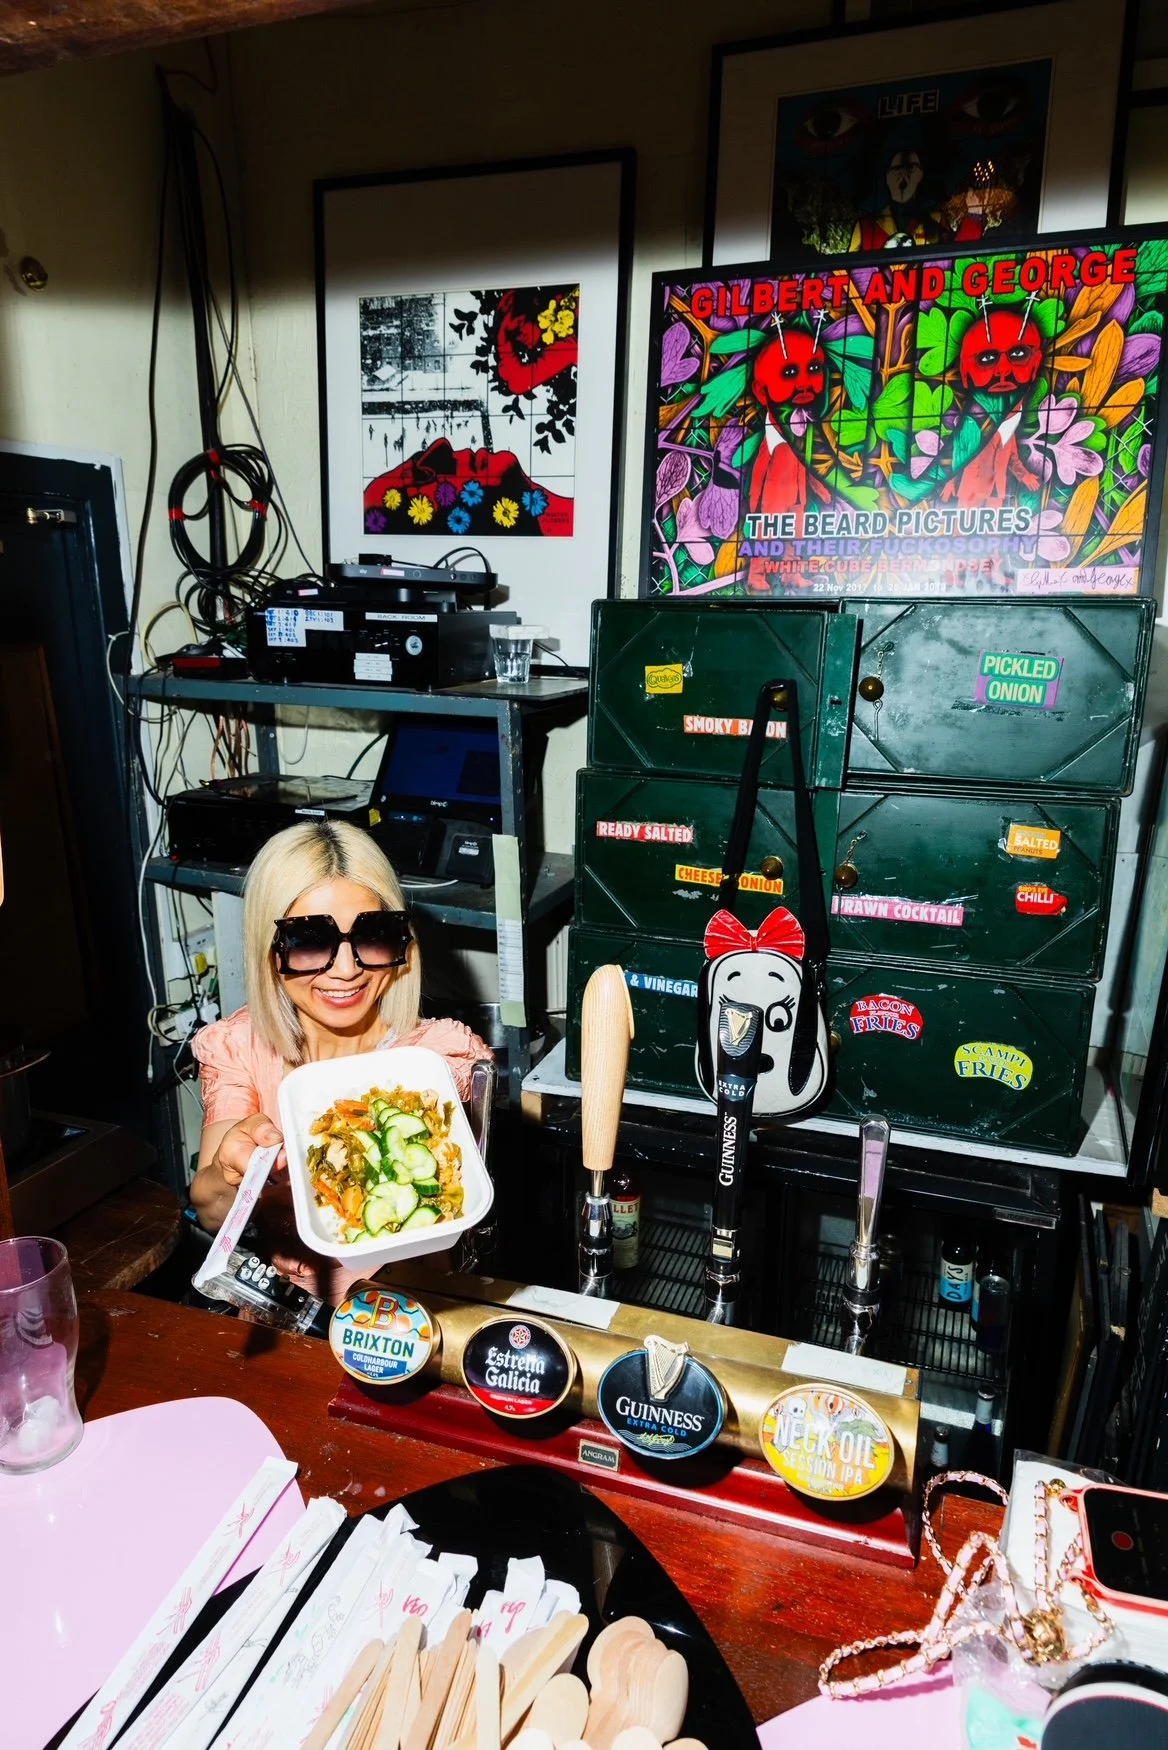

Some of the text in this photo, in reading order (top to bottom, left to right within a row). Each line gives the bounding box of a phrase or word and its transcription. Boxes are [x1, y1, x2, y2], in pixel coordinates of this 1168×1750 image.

[877, 88, 940, 120] LIFE
[691, 249, 1137, 319] GILBERT AND GEORGE
[746, 506, 1032, 539] THE BEARD PICTURES
[738, 536, 1038, 556] AND THEIR FUCKOSOPHY
[764, 557, 1003, 574] WHITE CUBE BERMONDSEY
[813, 583, 824, 592] 22
[826, 583, 843, 593] Nov
[983, 655, 1057, 679] PICKLED
[988, 681, 1044, 704] ONION
[685, 716, 787, 738] SMOKY BON
[599, 821, 693, 843] READY SALTED
[1014, 835, 1059, 850] SALTED
[678, 867, 782, 893] CHEESE ONION
[1016, 892, 1054, 904] CHILLI
[834, 898, 961, 924] PRAWN COCKTAIL
[629, 975, 640, 987] &
[857, 999, 915, 1017] BACON
[850, 1015, 920, 1040] FRIES
[962, 1045, 1027, 1067] SCAMPI
[718, 1079, 746, 1091] EXTRA
[957, 1060, 1028, 1090] FRIES
[718, 1085, 746, 1097] COLD
[718, 1115, 738, 1187] GUINNESS
[946, 1266, 964, 1300] DAYS
[342, 1328, 415, 1358] BRIXTON
[352, 1353, 398, 1369] COLDHARBOUR
[364, 1364, 384, 1374] LAGER
[485, 1346, 546, 1375] Estrella
[485, 1366, 540, 1394] Galicia
[615, 1396, 703, 1432] GUINNESS
[626, 1417, 687, 1438] EXTRA COLD
[773, 1413, 876, 1470] NECK OIL
[582, 1448, 615, 1464] ANGRAM
[783, 1451, 837, 1480] SESSION
[840, 1464, 864, 1486] IPA
